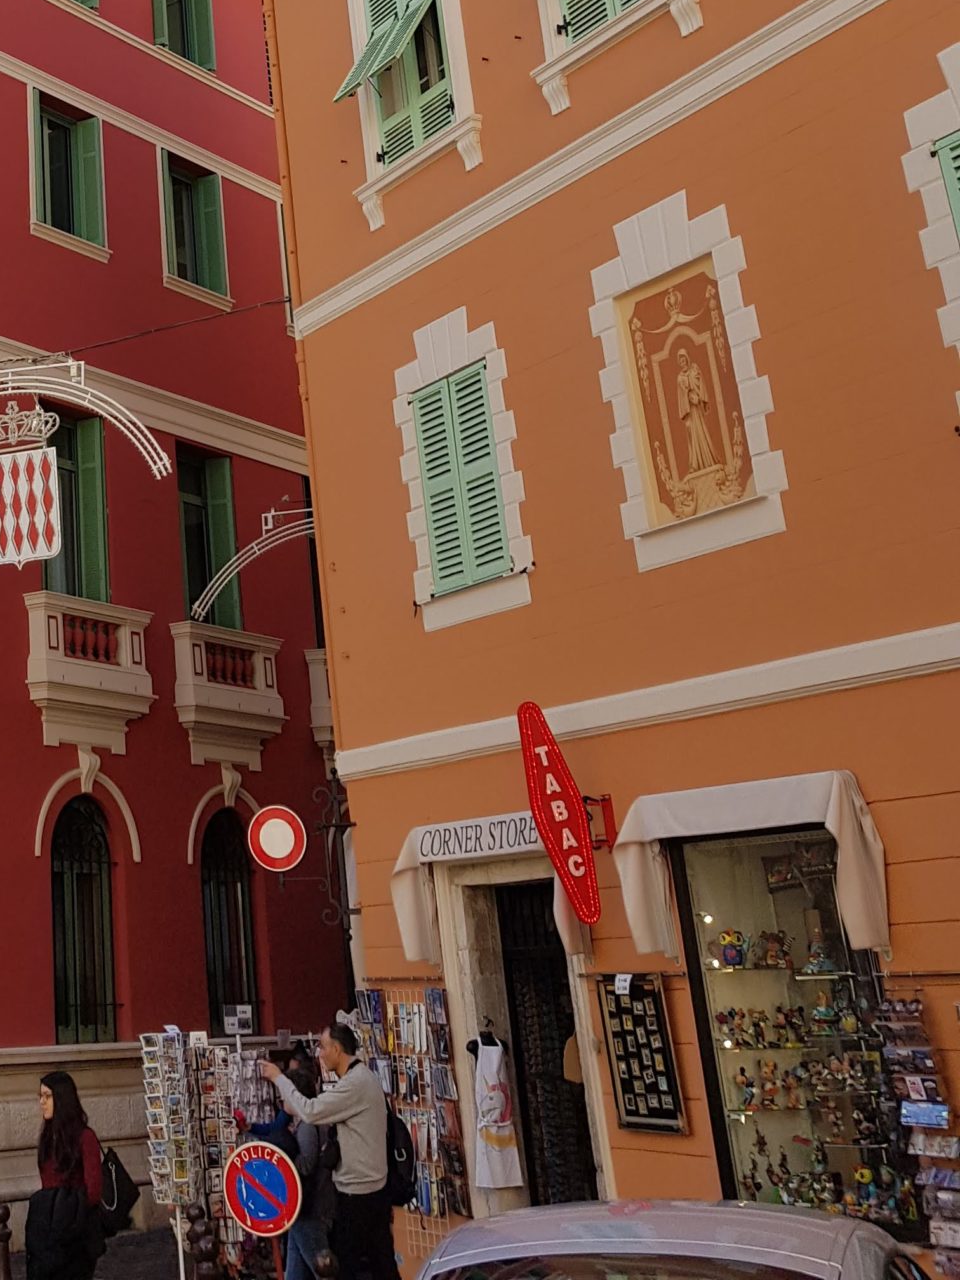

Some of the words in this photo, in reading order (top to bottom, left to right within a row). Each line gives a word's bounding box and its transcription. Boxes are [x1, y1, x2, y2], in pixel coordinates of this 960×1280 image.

[534, 745, 586, 877] TABAC
[420, 824, 483, 857] CORNER
[488, 817, 538, 851] STORE
[233, 1146, 281, 1169] POLICE
